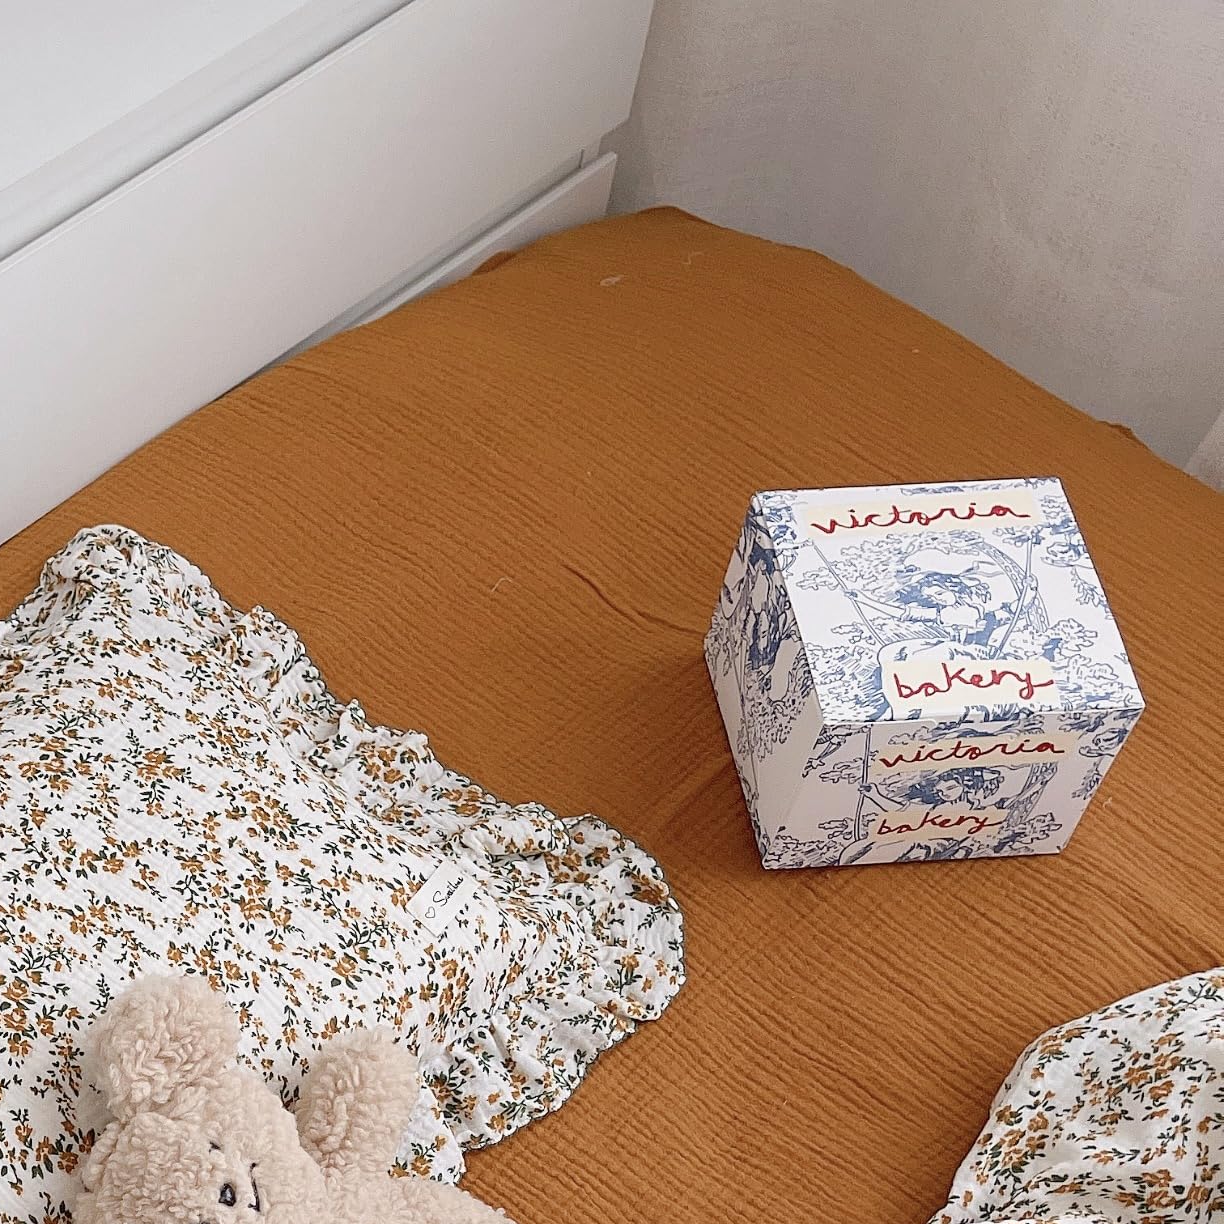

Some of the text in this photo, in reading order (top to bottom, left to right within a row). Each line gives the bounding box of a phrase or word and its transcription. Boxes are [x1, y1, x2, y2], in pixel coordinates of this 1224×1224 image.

[810, 503, 1031, 534] victoria
[893, 663, 1055, 700] bakery
[879, 738, 1065, 768] victoria
[876, 809, 1002, 837] bakery
